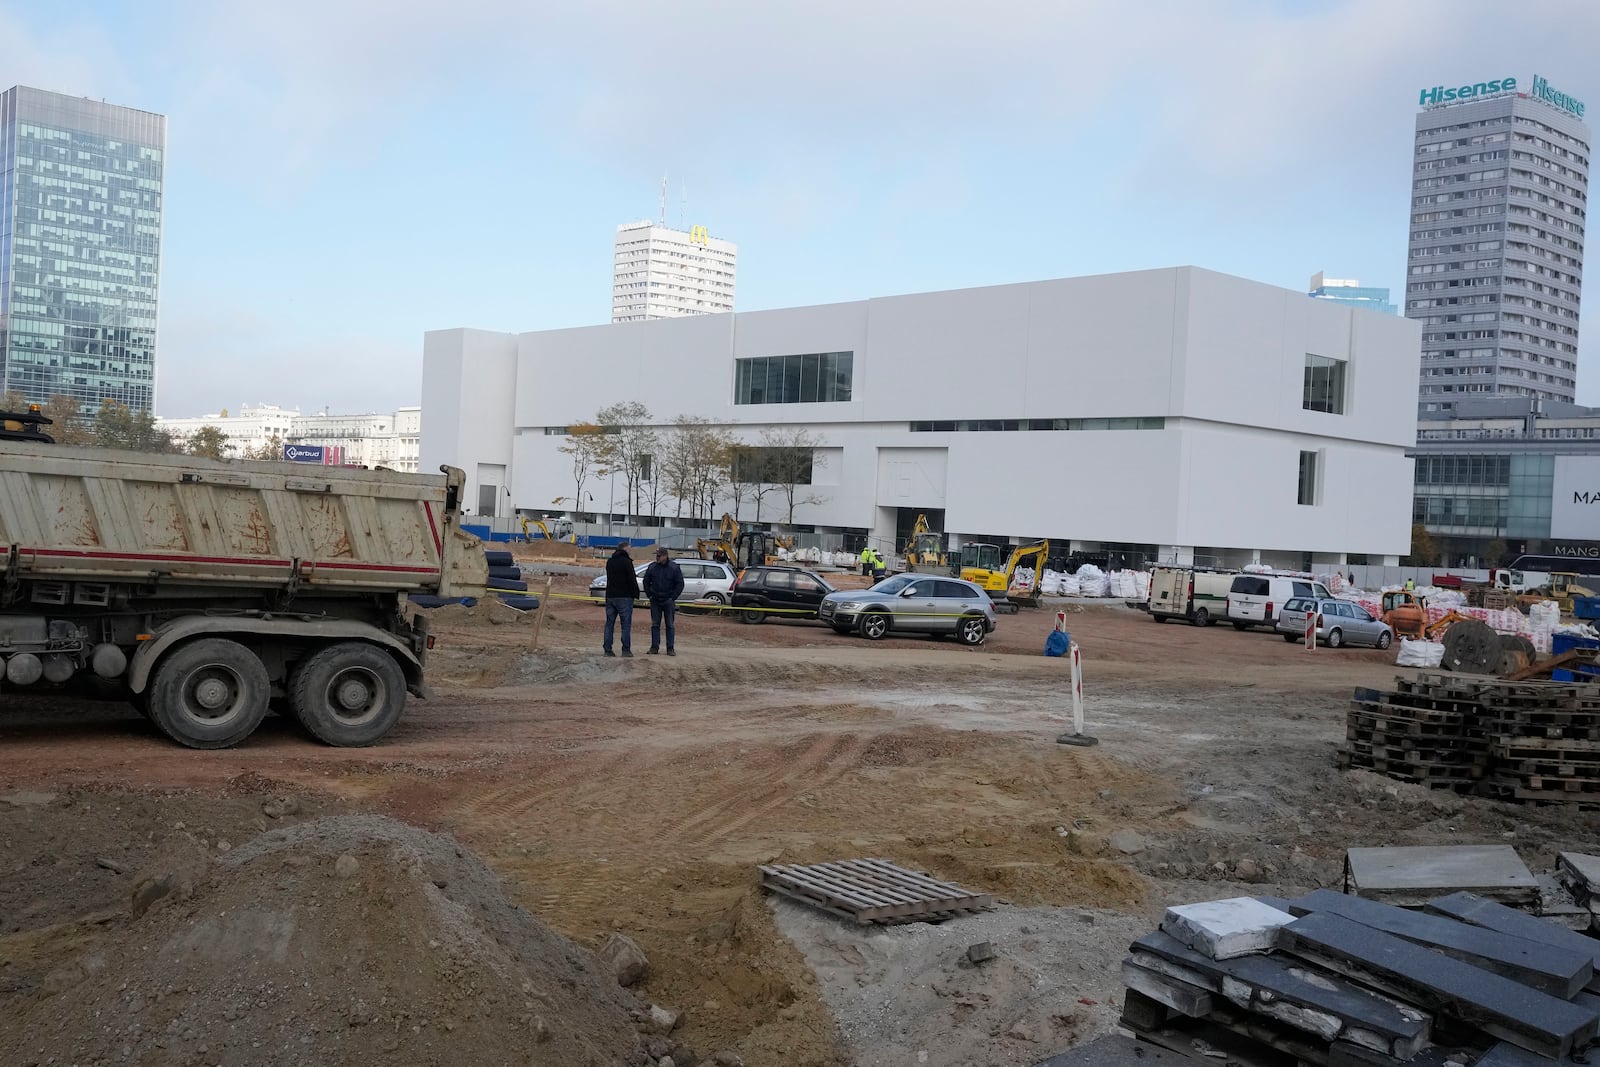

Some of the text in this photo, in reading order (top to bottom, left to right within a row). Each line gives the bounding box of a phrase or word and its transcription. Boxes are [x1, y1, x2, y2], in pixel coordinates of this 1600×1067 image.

[1419, 77, 1517, 105] Hisense
[1532, 74, 1586, 117] Hisense
[1555, 546, 1599, 557] MANG
